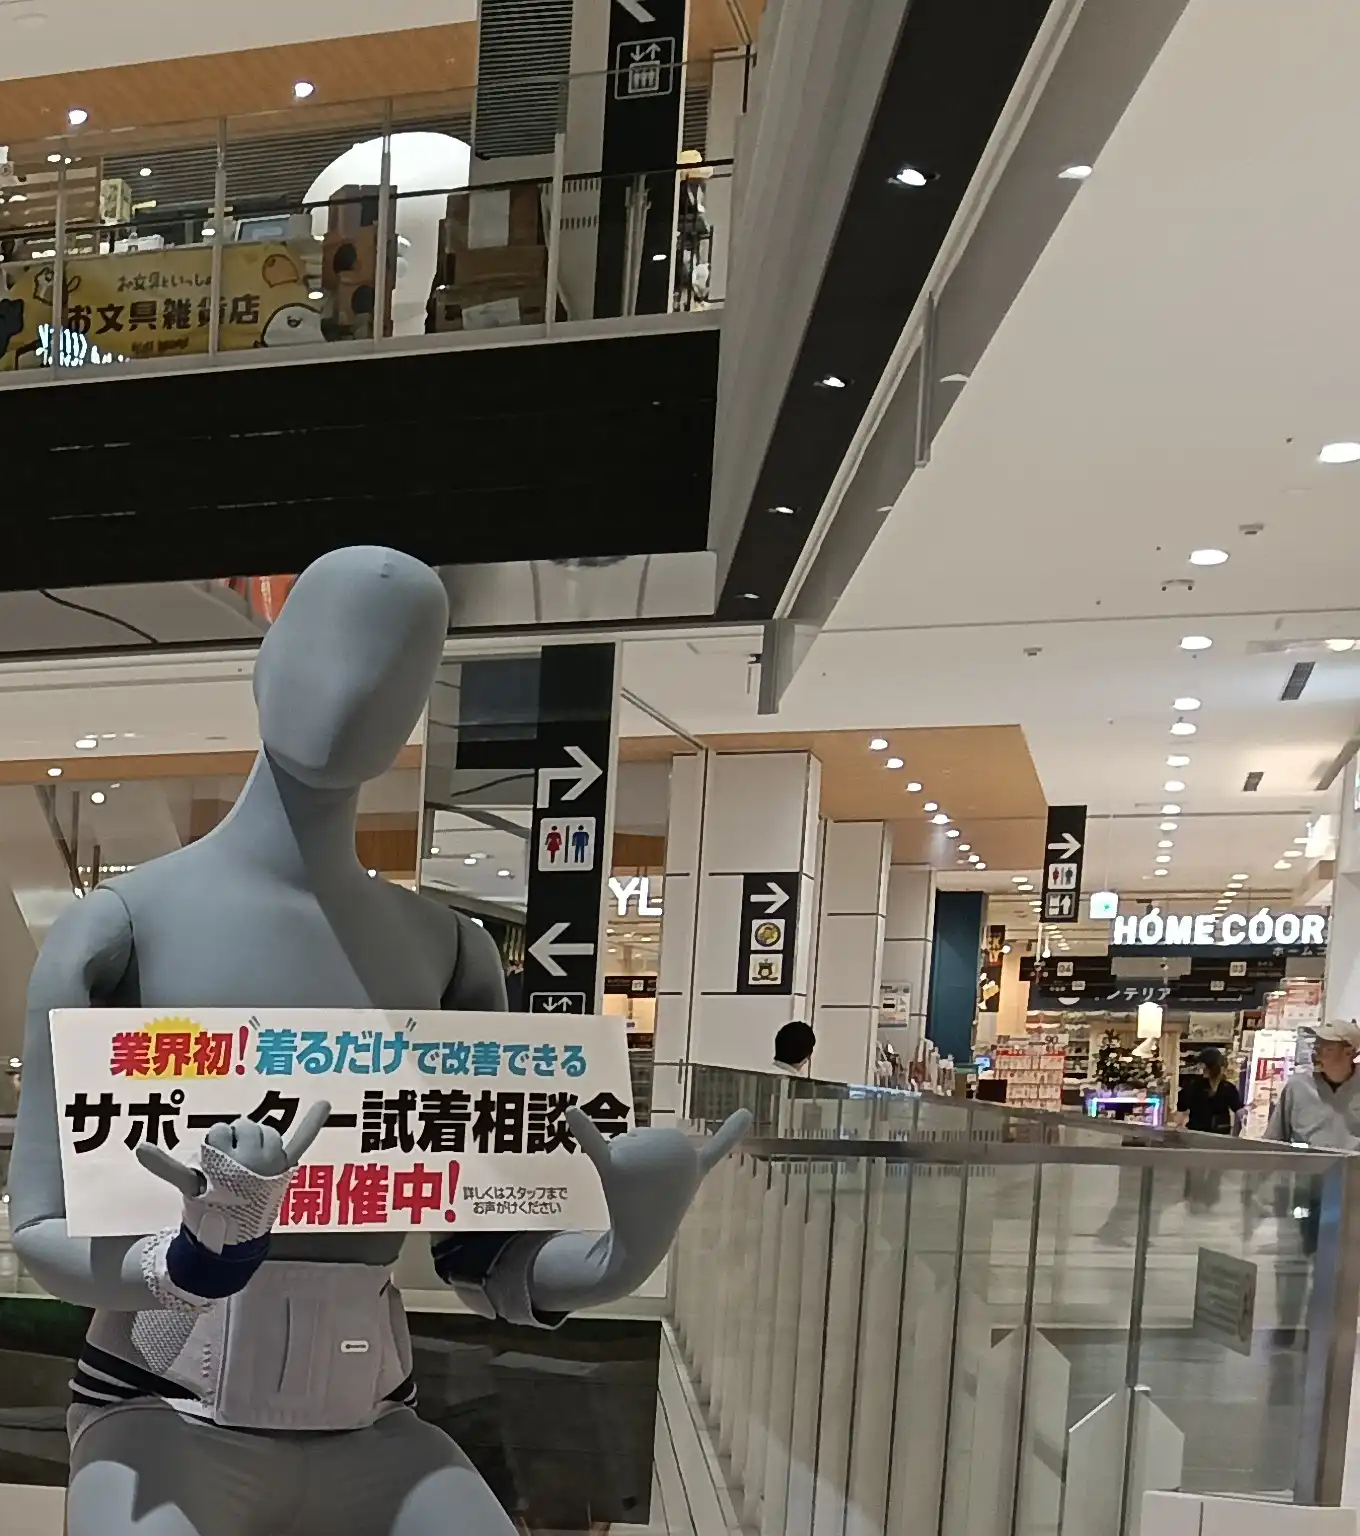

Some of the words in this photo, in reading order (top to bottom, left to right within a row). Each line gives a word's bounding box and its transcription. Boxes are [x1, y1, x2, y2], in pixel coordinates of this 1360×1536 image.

[463, 1186, 568, 1201] 詳しくはスタッフまで
[473, 1201, 562, 1215] お声がけください
